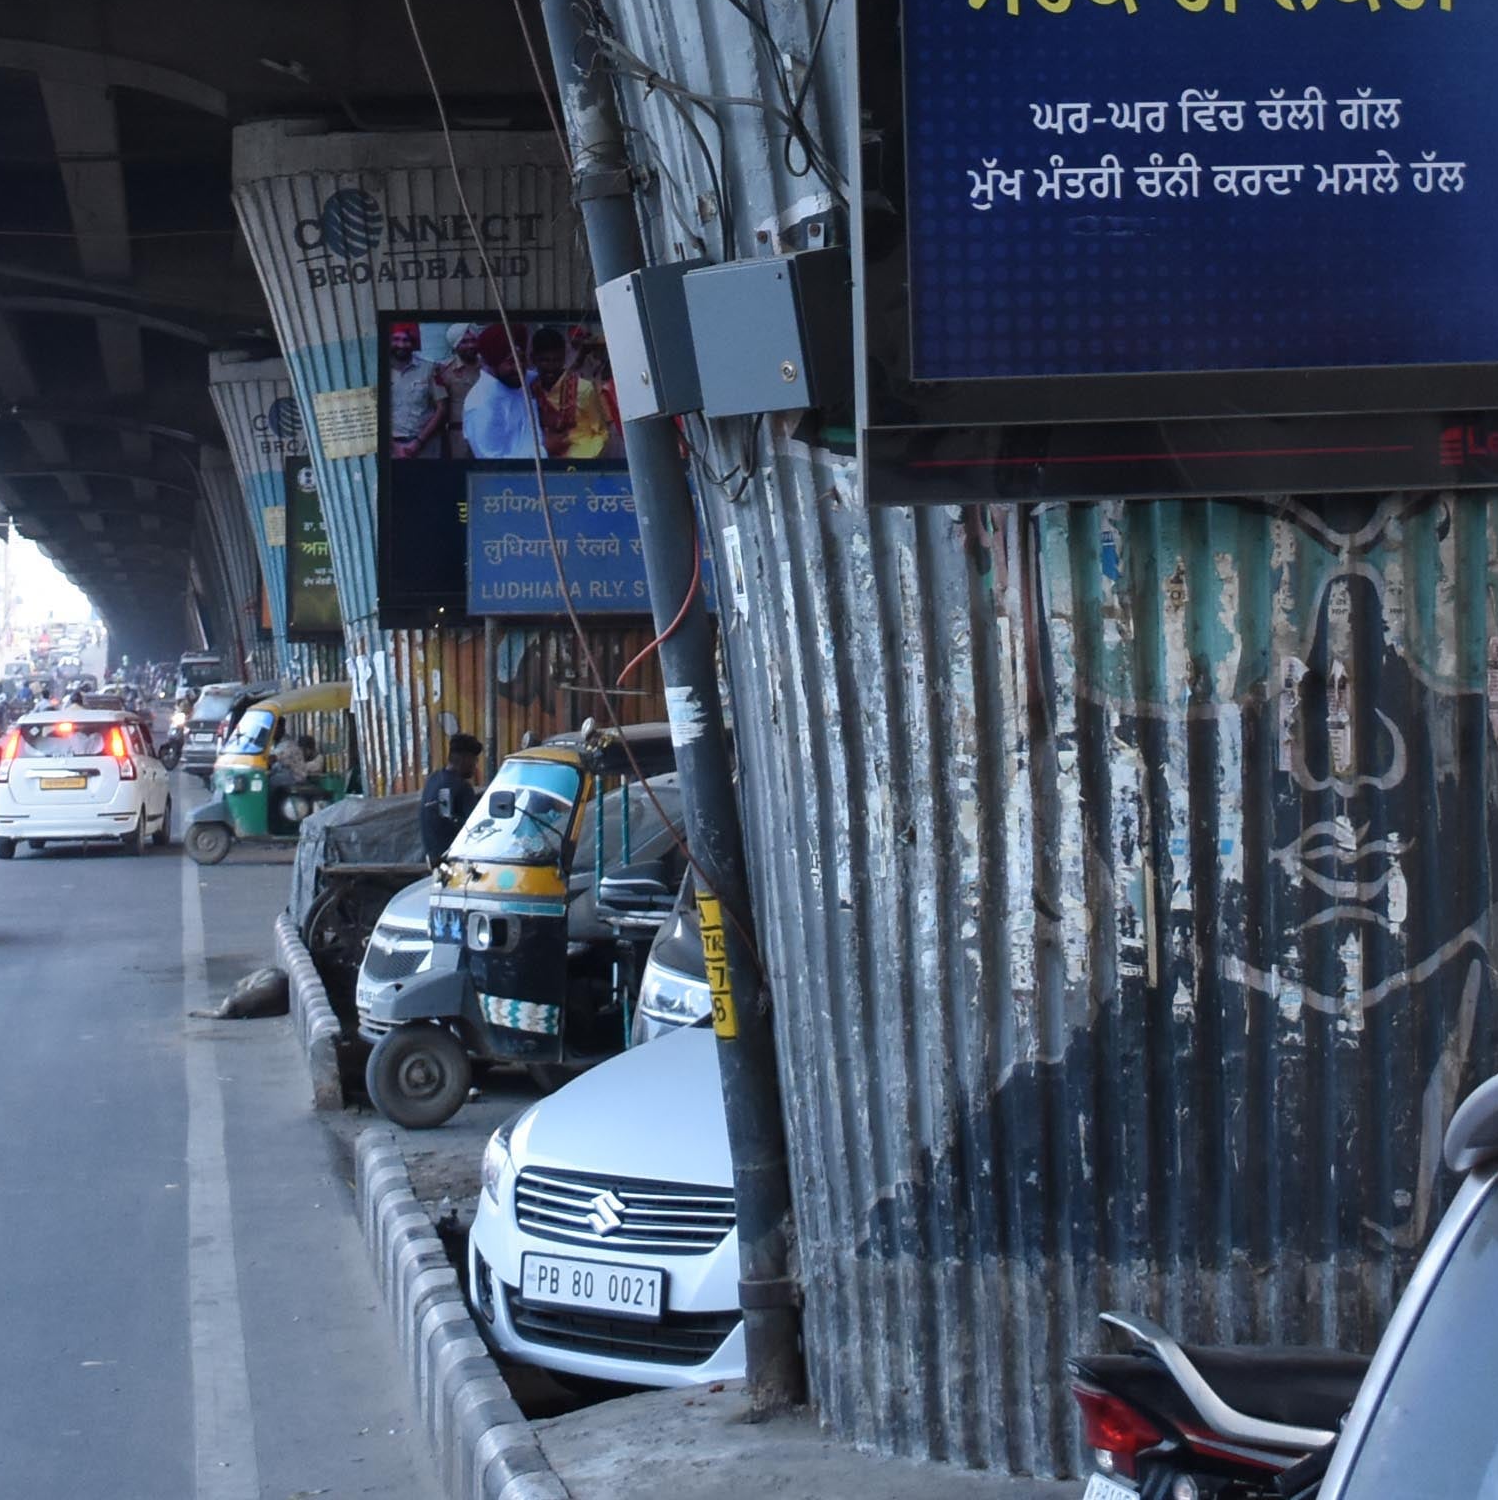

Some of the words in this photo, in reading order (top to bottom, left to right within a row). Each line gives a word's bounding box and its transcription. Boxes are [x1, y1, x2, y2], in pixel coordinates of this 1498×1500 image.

[1030, 100, 1168, 134] ਘਰ-ਘਰ
[1178, 87, 1246, 134] ਵਿੱਚ
[1255, 86, 1328, 131] ਚੱਲੀ
[1336, 86, 1402, 130] ਗੱਲ
[967, 157, 1023, 211] ਮੁੱਖ
[1033, 153, 1124, 201] ਮੰਤਰੀ
[1133, 151, 1202, 199] ਚੰਨੀ
[1212, 163, 1305, 198] ਕਰਦਾ
[1314, 149, 1401, 196] ਮਸਲੇ
[1410, 149, 1467, 194] ਹੱਲ
[308, 255, 530, 290] BROADBAND
[577, 532, 621, 557] रेलवे
[590, 580, 629, 598] RLY.
[537, 1264, 561, 1295] PB
[571, 1269, 595, 1299] 80
[607, 1273, 657, 1308] 0021
